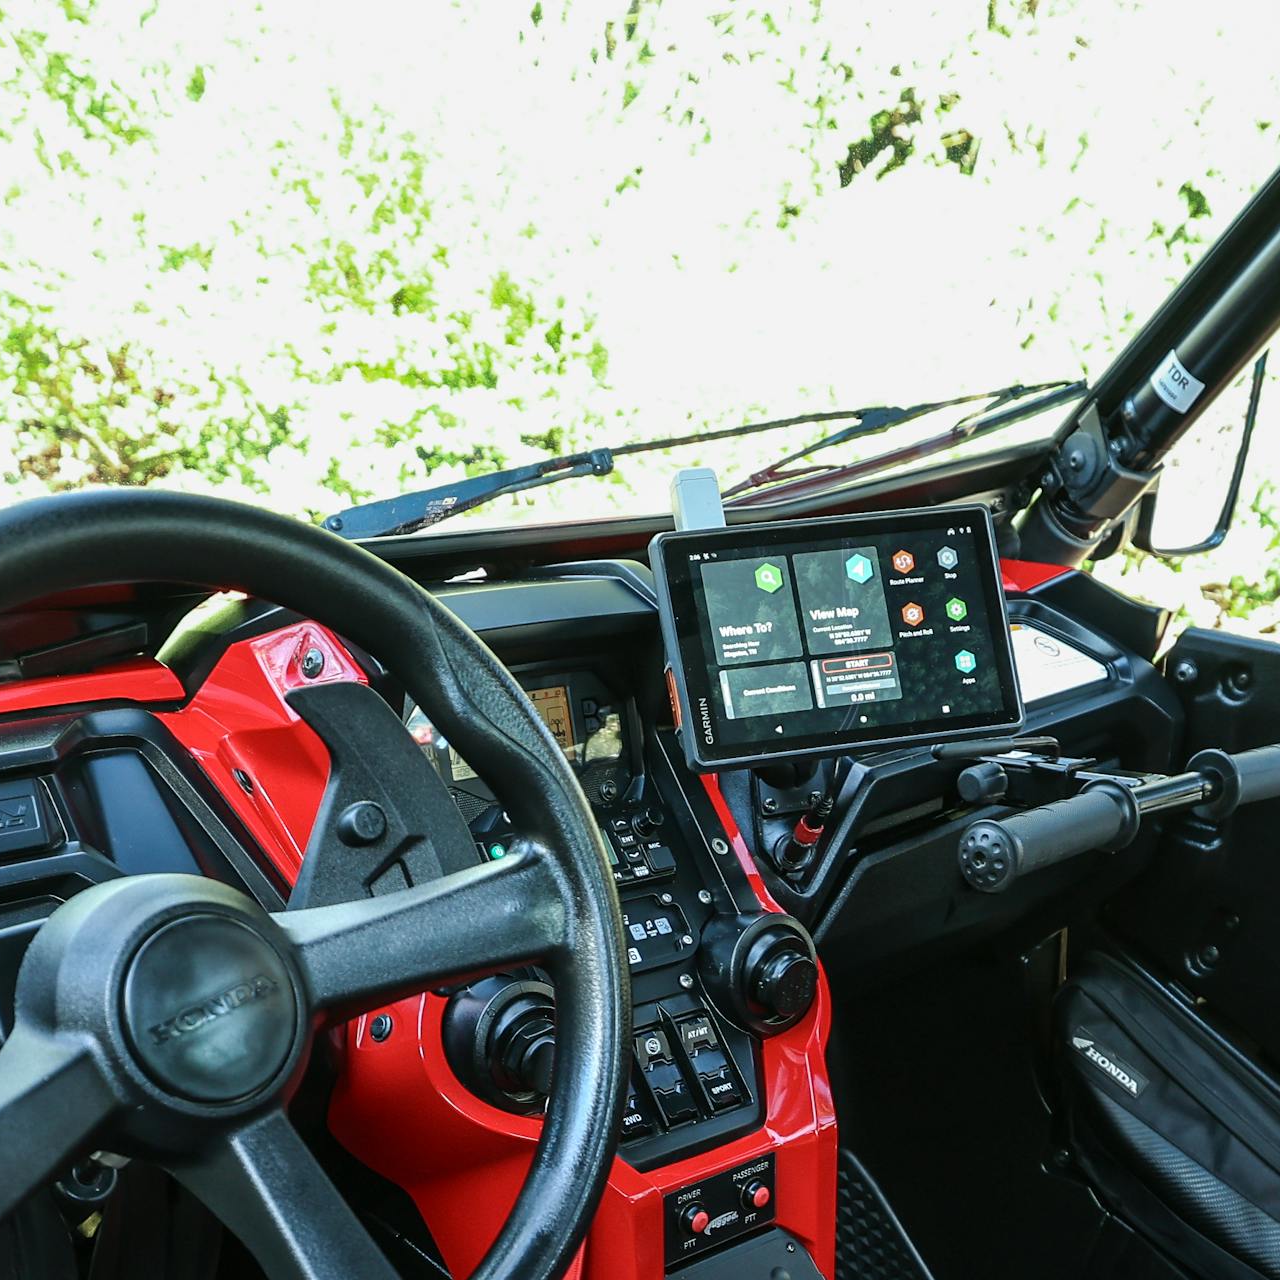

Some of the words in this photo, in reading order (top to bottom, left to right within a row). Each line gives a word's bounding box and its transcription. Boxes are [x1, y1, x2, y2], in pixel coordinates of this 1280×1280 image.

[1168, 362, 1190, 390] TDR
[889, 578, 905, 586] Route
[809, 609, 835, 620] View
[836, 607, 859, 618] Map
[719, 626, 753, 637] Where
[753, 622, 773, 633] To?
[950, 625, 970, 633] Settings
[845, 659, 869, 668] START
[962, 677, 976, 685] Apps
[851, 693, 864, 702] 0.0
[865, 692, 875, 701] mi
[698, 697, 714, 745] GARMIN
[622, 835, 634, 843] ENT
[648, 842, 661, 850] MIC
[148, 976, 278, 1045] HONDA
[687, 1026, 708, 1040] AT/MT
[1085, 1046, 1138, 1094] HONDA
[712, 1082, 733, 1095] SPORT
[622, 1114, 643, 1126] 2WD
[732, 1161, 769, 1182] PASSENGER
[677, 1188, 702, 1205] DRIVER
[744, 1212, 757, 1224] PTT
[683, 1238, 697, 1250] PTT
